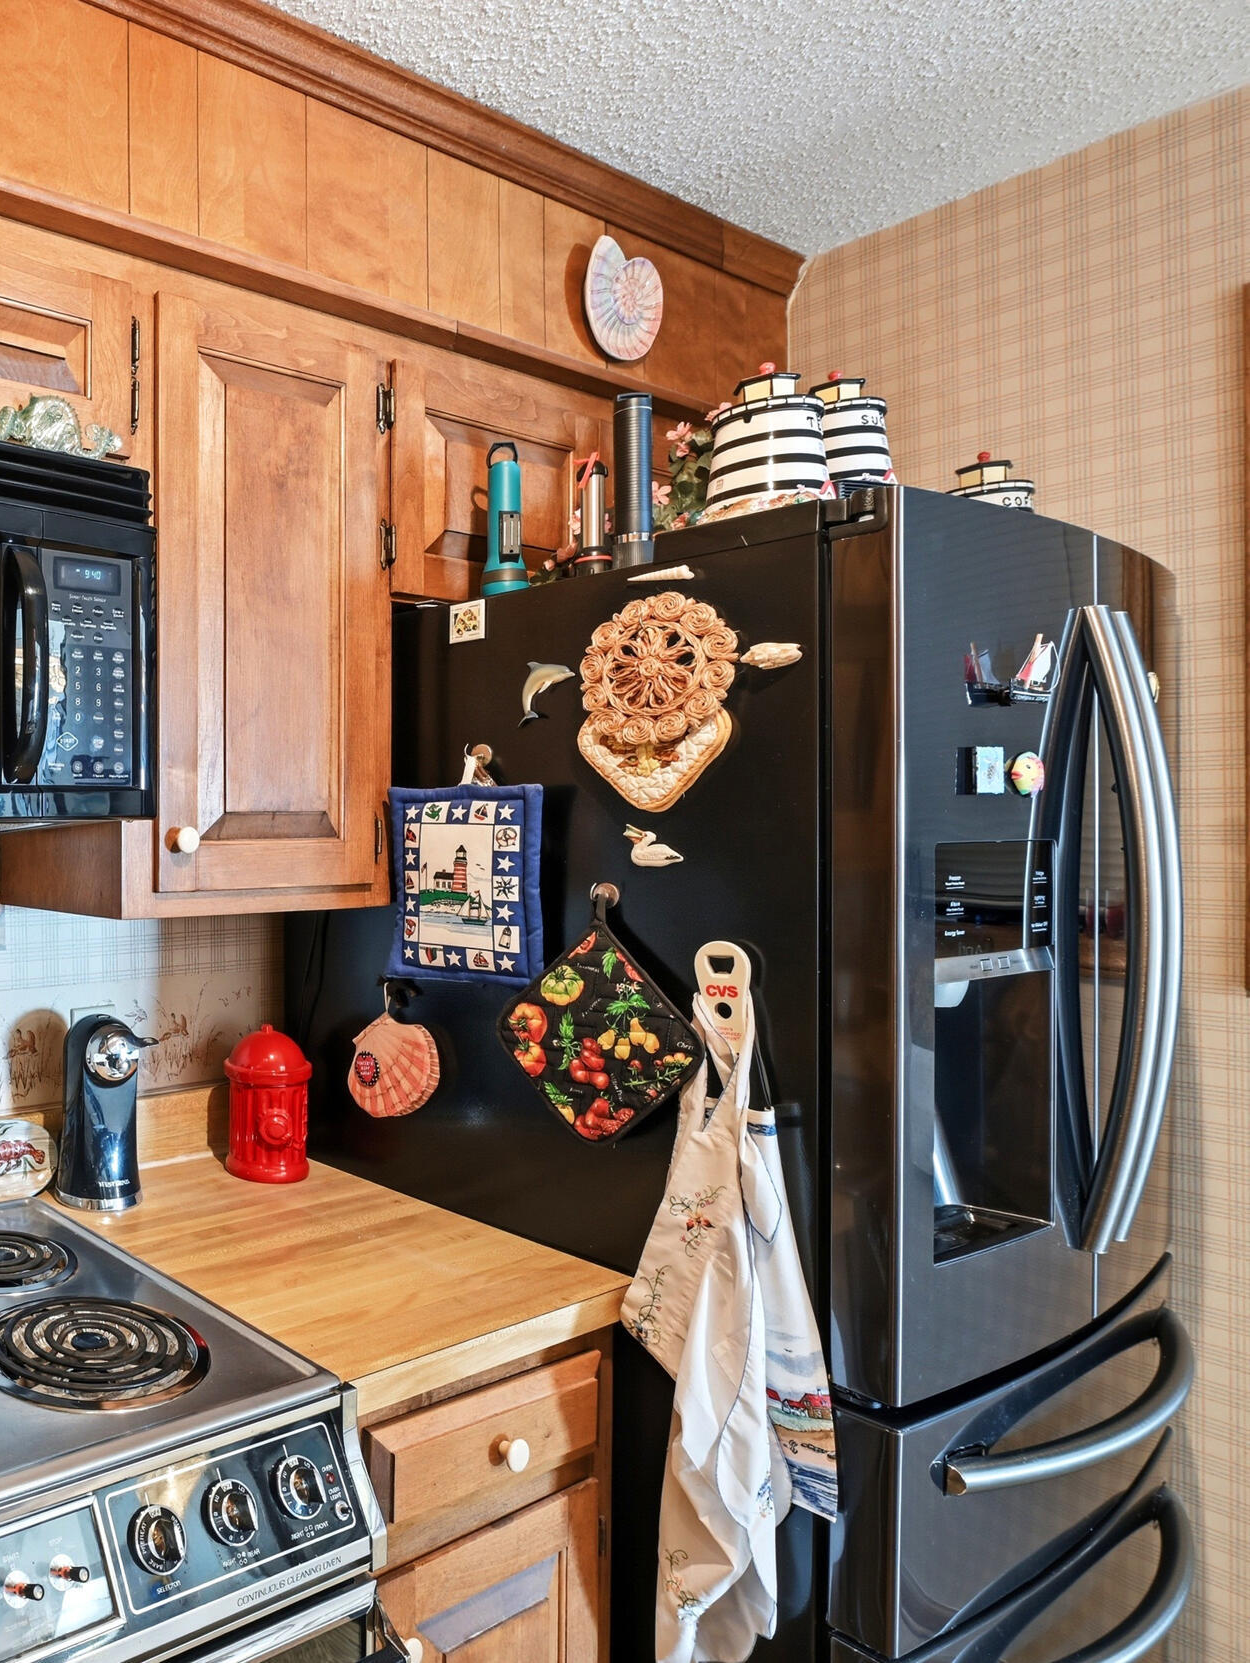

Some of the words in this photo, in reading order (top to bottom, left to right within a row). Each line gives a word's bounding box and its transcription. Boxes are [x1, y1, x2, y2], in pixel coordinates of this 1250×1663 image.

[75, 665, 81, 674] 2
[95, 667, 101, 676] 3
[75, 681, 81, 690] 5
[95, 683, 102, 692] 6
[75, 697, 81, 706] 8
[95, 698, 102, 707] 9
[75, 712, 81, 722] 0
[705, 984, 739, 998] CVS
